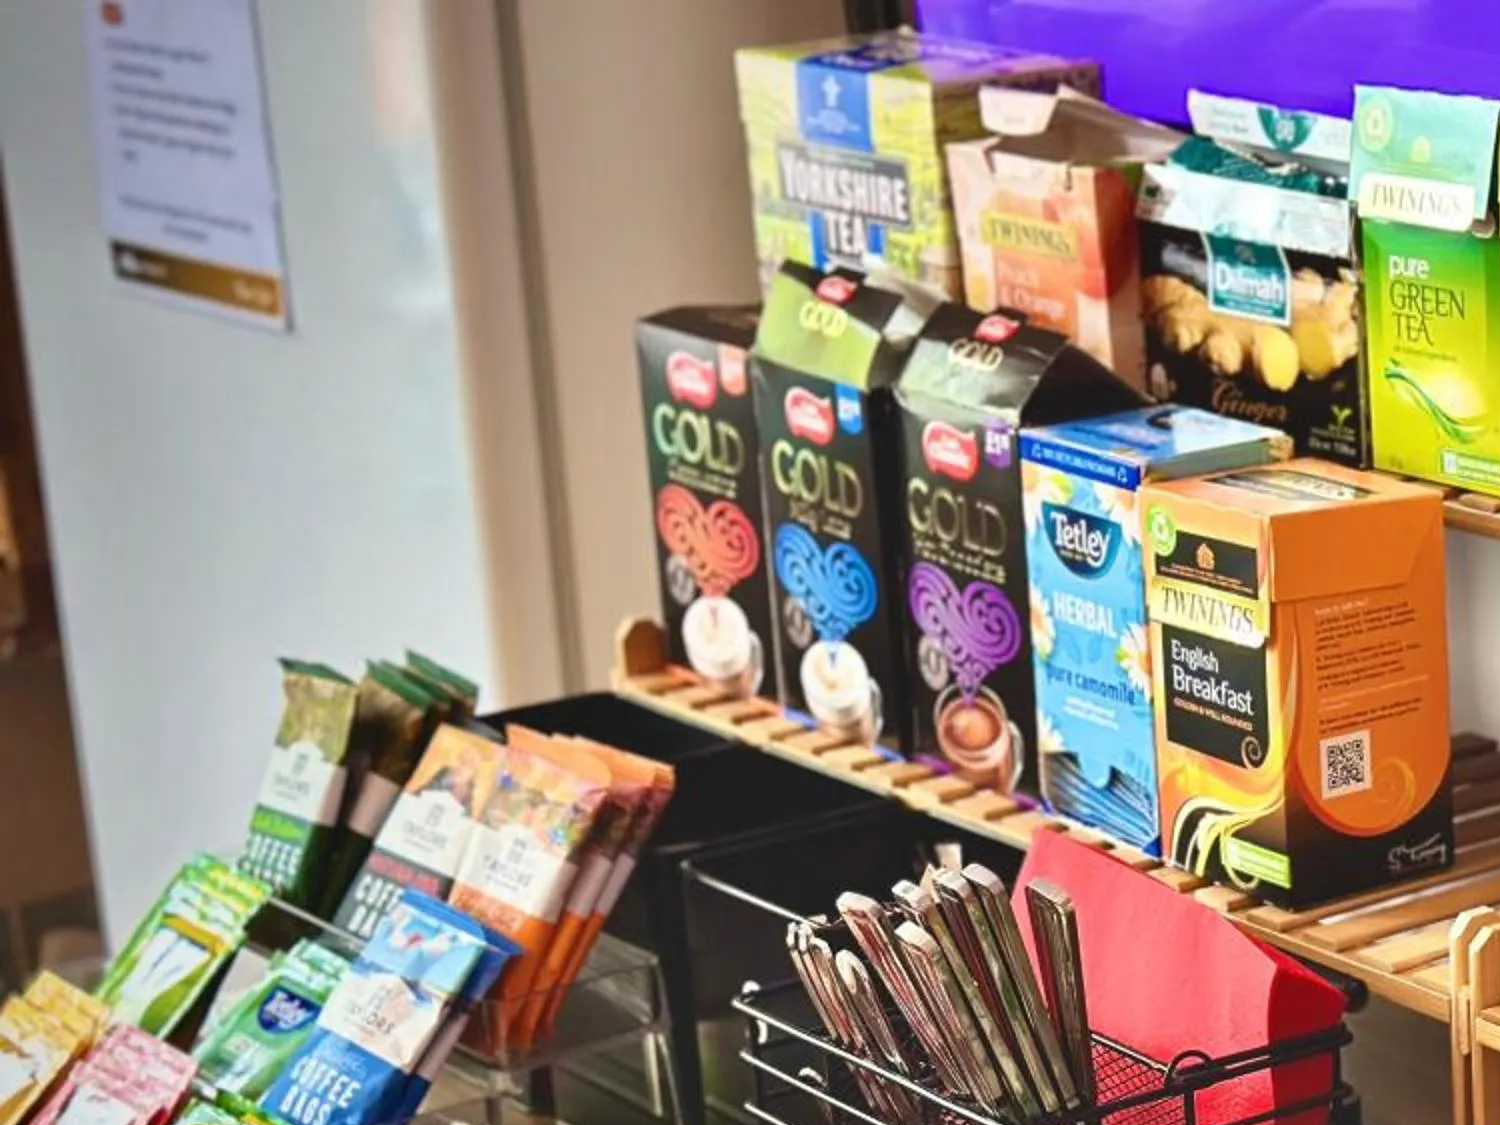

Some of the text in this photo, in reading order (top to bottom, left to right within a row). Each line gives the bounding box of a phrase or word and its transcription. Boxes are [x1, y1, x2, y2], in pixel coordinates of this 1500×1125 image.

[824, 210, 867, 254] TEA
[1389, 255, 1431, 279] pure
[801, 301, 846, 337] GOLD
[1389, 280, 1465, 320] GREEN
[1392, 312, 1435, 347] TEA
[653, 402, 744, 475] GOLD
[771, 438, 863, 519] GOLD
[907, 476, 1008, 558] GOLD
[1049, 511, 1110, 567] Tetley
[1053, 590, 1118, 640] HERBAL
[1161, 585, 1256, 634] TWININGS
[1170, 638, 1219, 673] English
[1075, 672, 1136, 706] camomile
[1171, 663, 1255, 716] Breakfast
